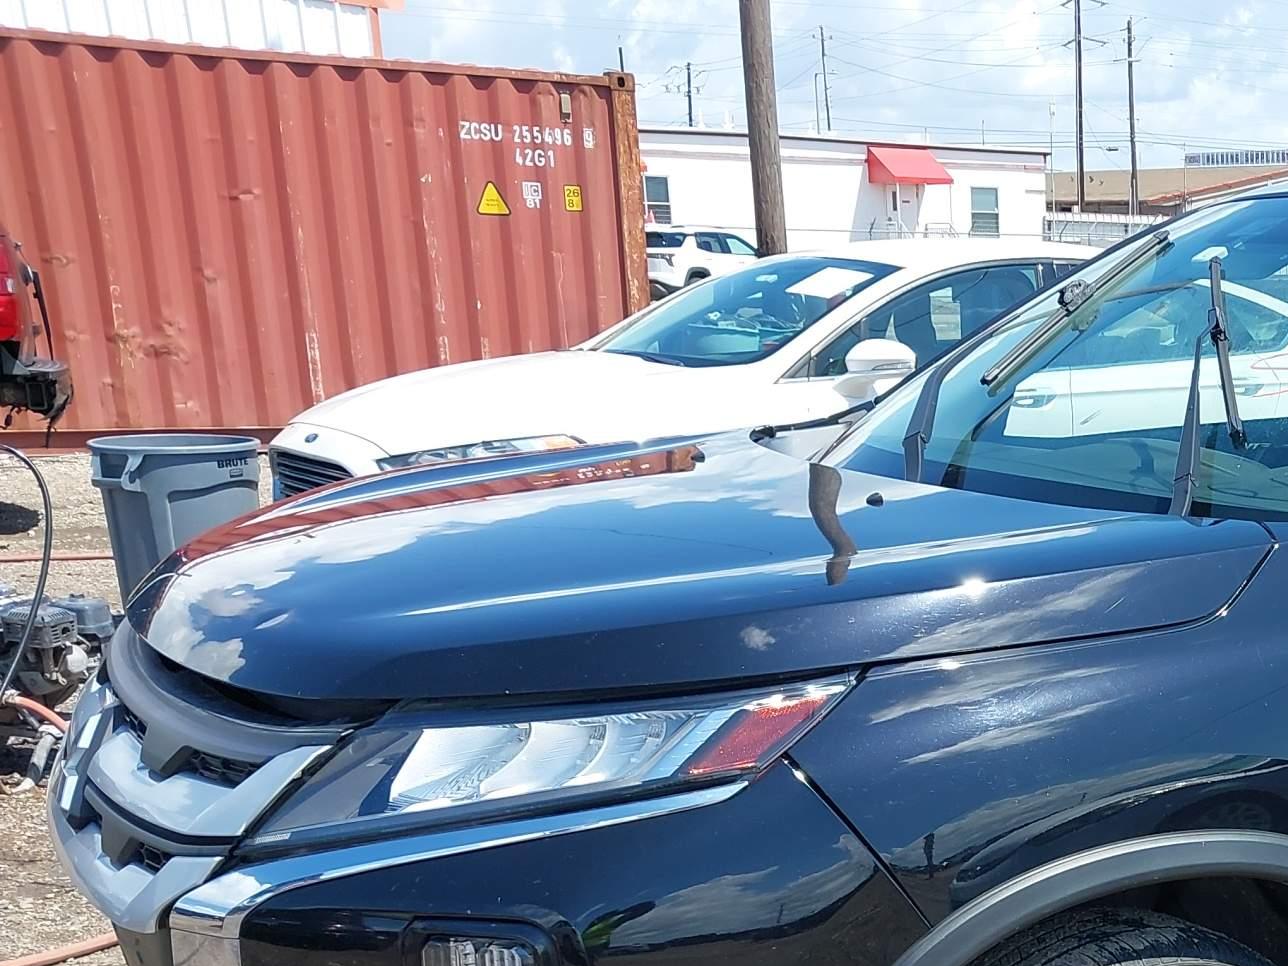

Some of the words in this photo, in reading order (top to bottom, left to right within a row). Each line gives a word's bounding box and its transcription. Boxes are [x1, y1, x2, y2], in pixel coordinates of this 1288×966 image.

[459, 120, 502, 141] ZCSU
[513, 124, 572, 146] 255496
[515, 148, 555, 168] 42G1
[217, 456, 248, 468] BRUTE
